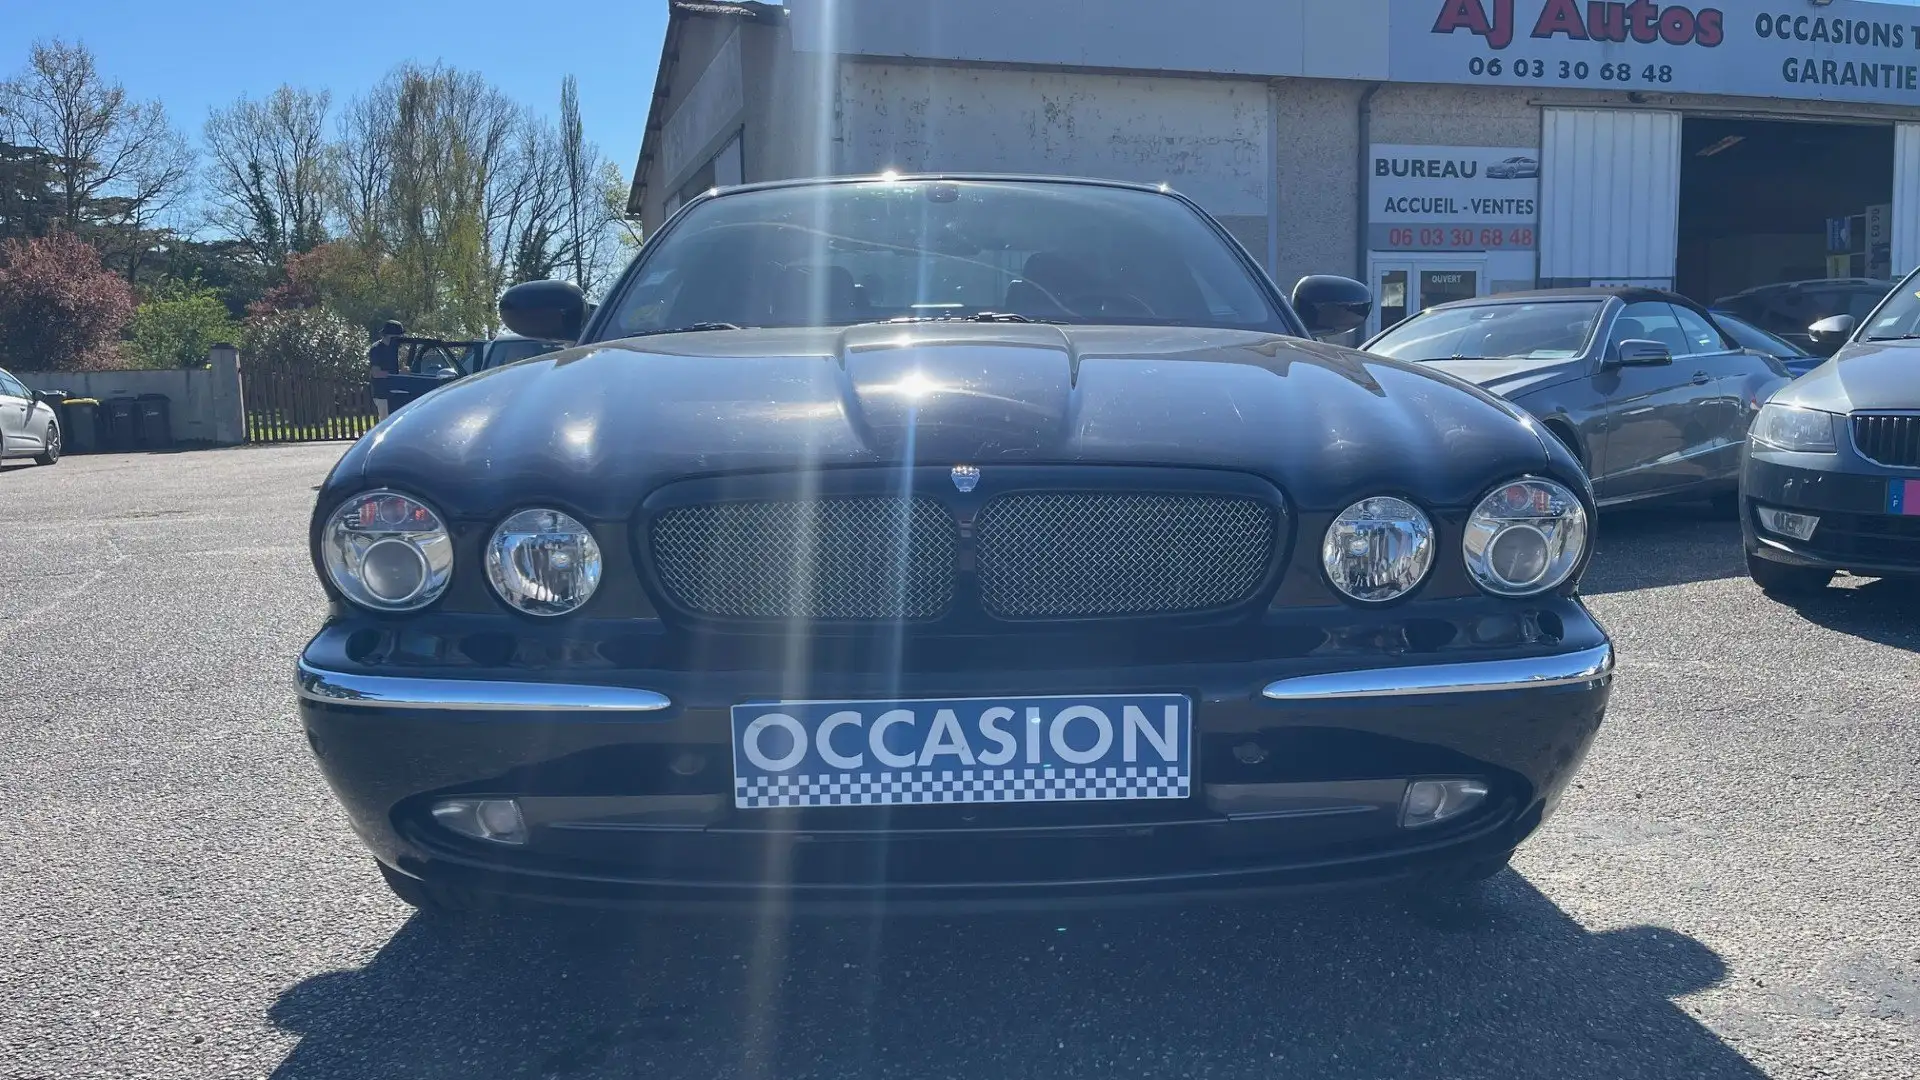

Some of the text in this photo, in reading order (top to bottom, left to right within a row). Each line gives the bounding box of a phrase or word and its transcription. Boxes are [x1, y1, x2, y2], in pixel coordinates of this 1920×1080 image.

[1431, 0, 1724, 50] AJ Autos
[1755, 12, 1904, 48] OCCASIONS
[1468, 57, 1673, 83] 06 03 30 68 48
[1782, 57, 1917, 90] GARANTIE
[1375, 158, 1477, 178] BUREAU
[1384, 197, 1459, 214] ACCUEIL
[1471, 198, 1534, 215] VENTES
[1390, 228, 1533, 247] 06 03 30 68 48
[1431, 275, 1462, 283] OUVERT
[743, 705, 1178, 772] OCCASION
